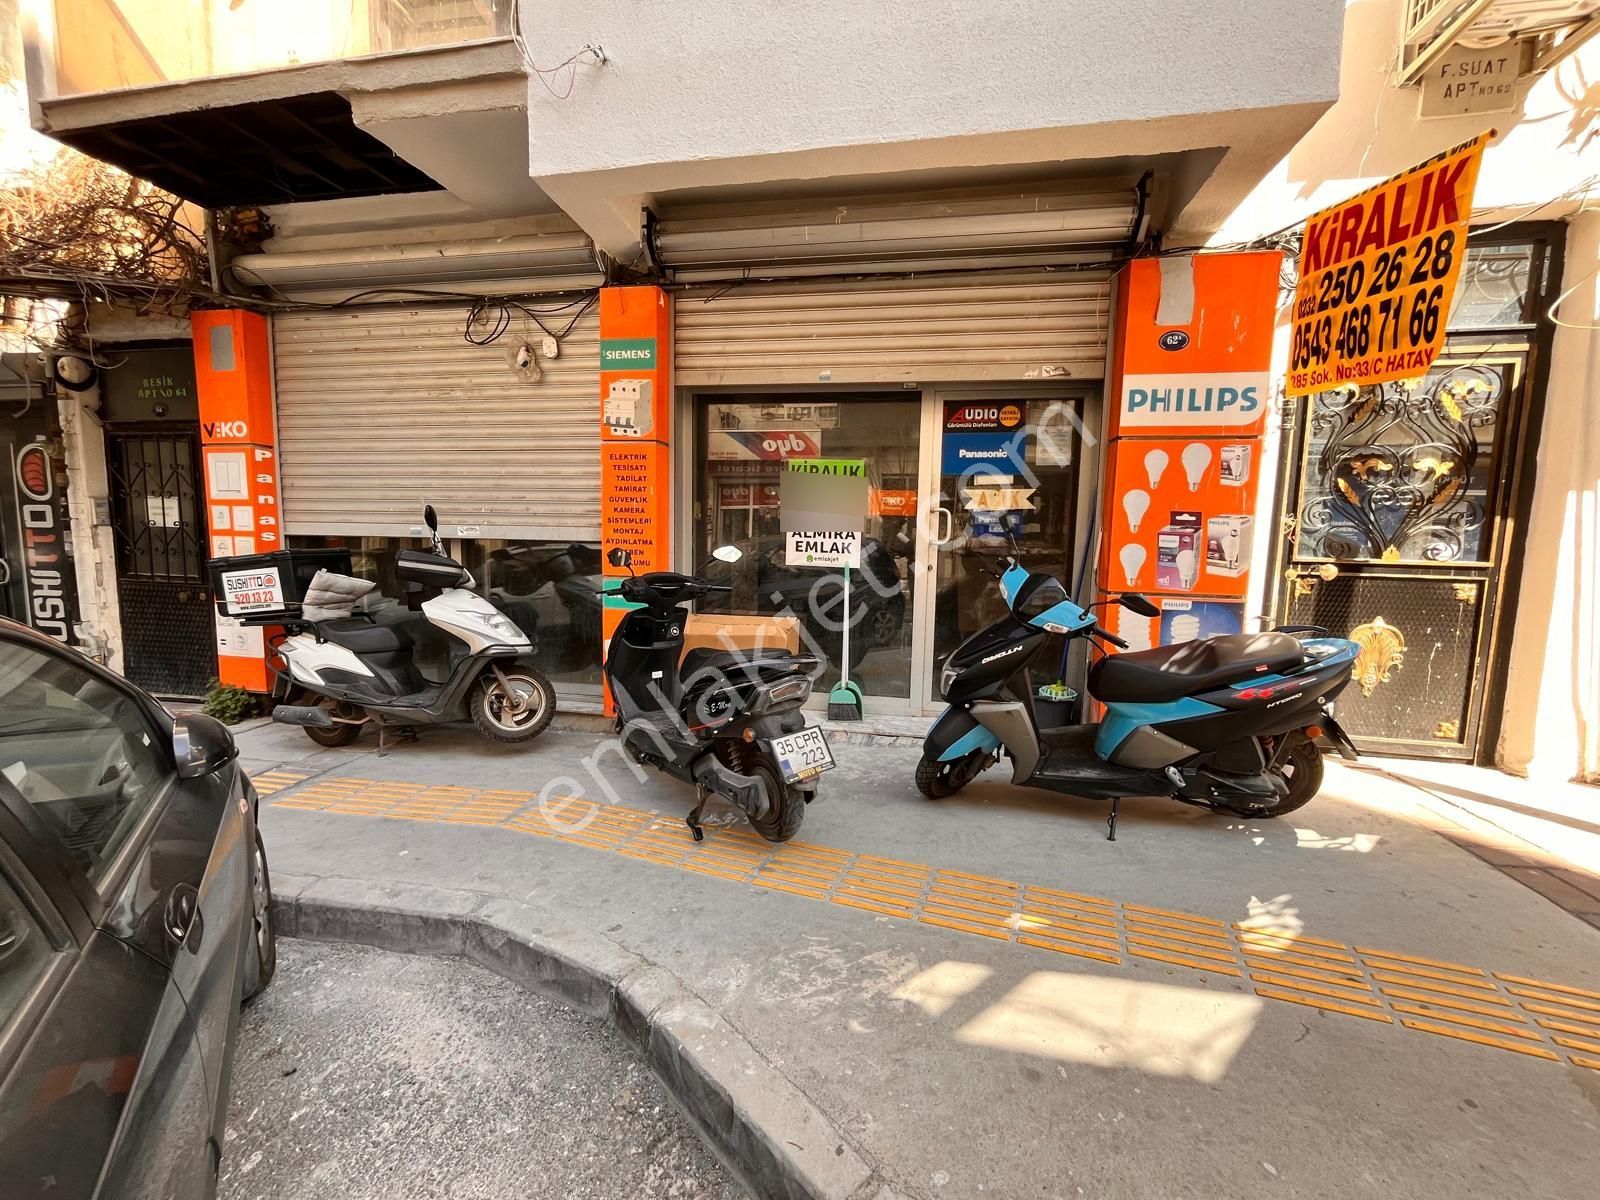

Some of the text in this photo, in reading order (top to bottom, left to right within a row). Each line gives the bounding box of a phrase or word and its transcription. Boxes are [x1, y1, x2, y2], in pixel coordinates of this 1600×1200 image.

[1443, 81, 1480, 99] APT
[1317, 260, 1365, 313] 250
[1366, 246, 1407, 298] 26
[1409, 229, 1456, 286] 28
[1291, 284, 1444, 372] 0543 468 71 66
[605, 349, 651, 360] SIEMENS
[1309, 367, 1333, 386] Sok.
[1336, 358, 1384, 382] No:33/C
[1385, 346, 1435, 373] HATAY
[138, 389, 157, 399] APT
[1126, 386, 1259, 413] PHILIPS
[951, 407, 998, 421] AUDIO
[609, 453, 648, 461] ELEKTRİK
[958, 448, 1009, 458] Panasonic
[616, 474, 648, 482] TADİLAT
[614, 485, 648, 493] TAMİRAT
[613, 506, 646, 514] KAMERA
[607, 517, 652, 525] SİSTEMLERİ
[612, 527, 644, 535] MONTAJ
[605, 537, 654, 546] AYDINLATMA
[795, 541, 853, 554] EMLAK
[23, 504, 68, 642] USHITTO
[226, 576, 263, 590] SUSHITTO
[234, 590, 273, 605] 520 13 23
[776, 730, 822, 756] 35 CPR
[801, 746, 827, 766] 223
